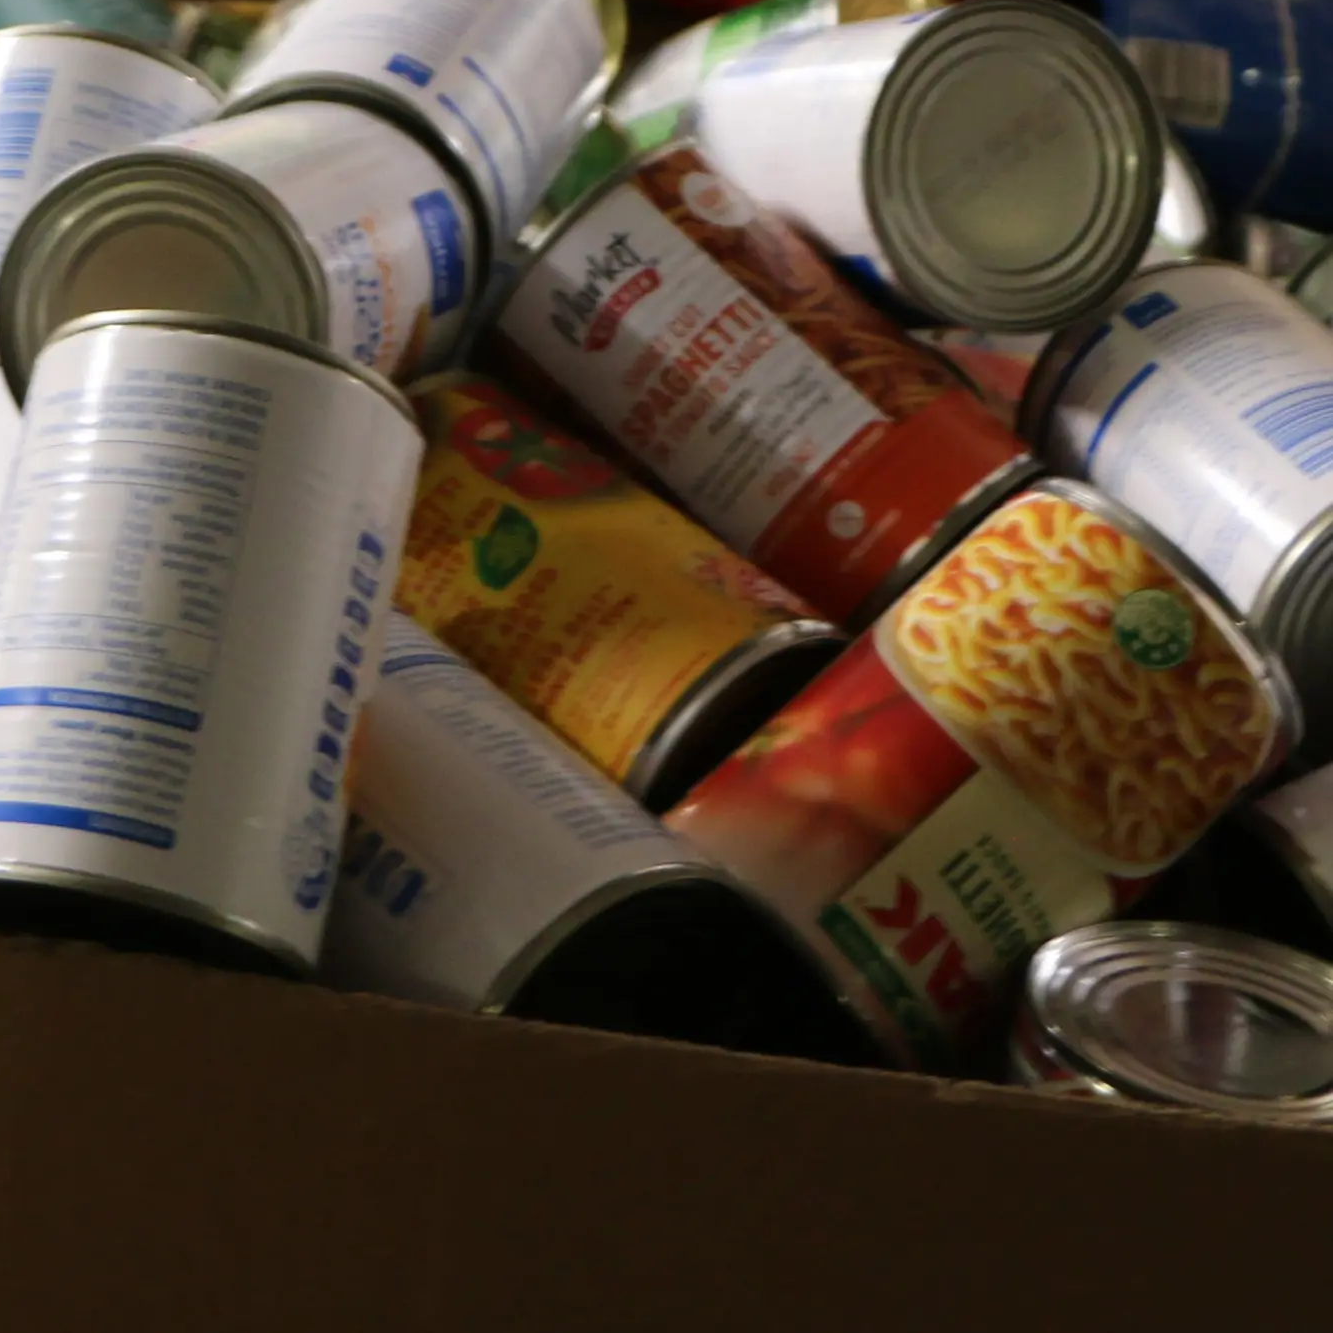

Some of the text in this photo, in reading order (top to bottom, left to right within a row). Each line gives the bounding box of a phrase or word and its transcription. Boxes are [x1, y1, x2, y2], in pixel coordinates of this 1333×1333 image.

[545, 232, 642, 346] Market
[616, 292, 764, 451] SPAGHETTI
[937, 848, 1034, 966] GHETTI
